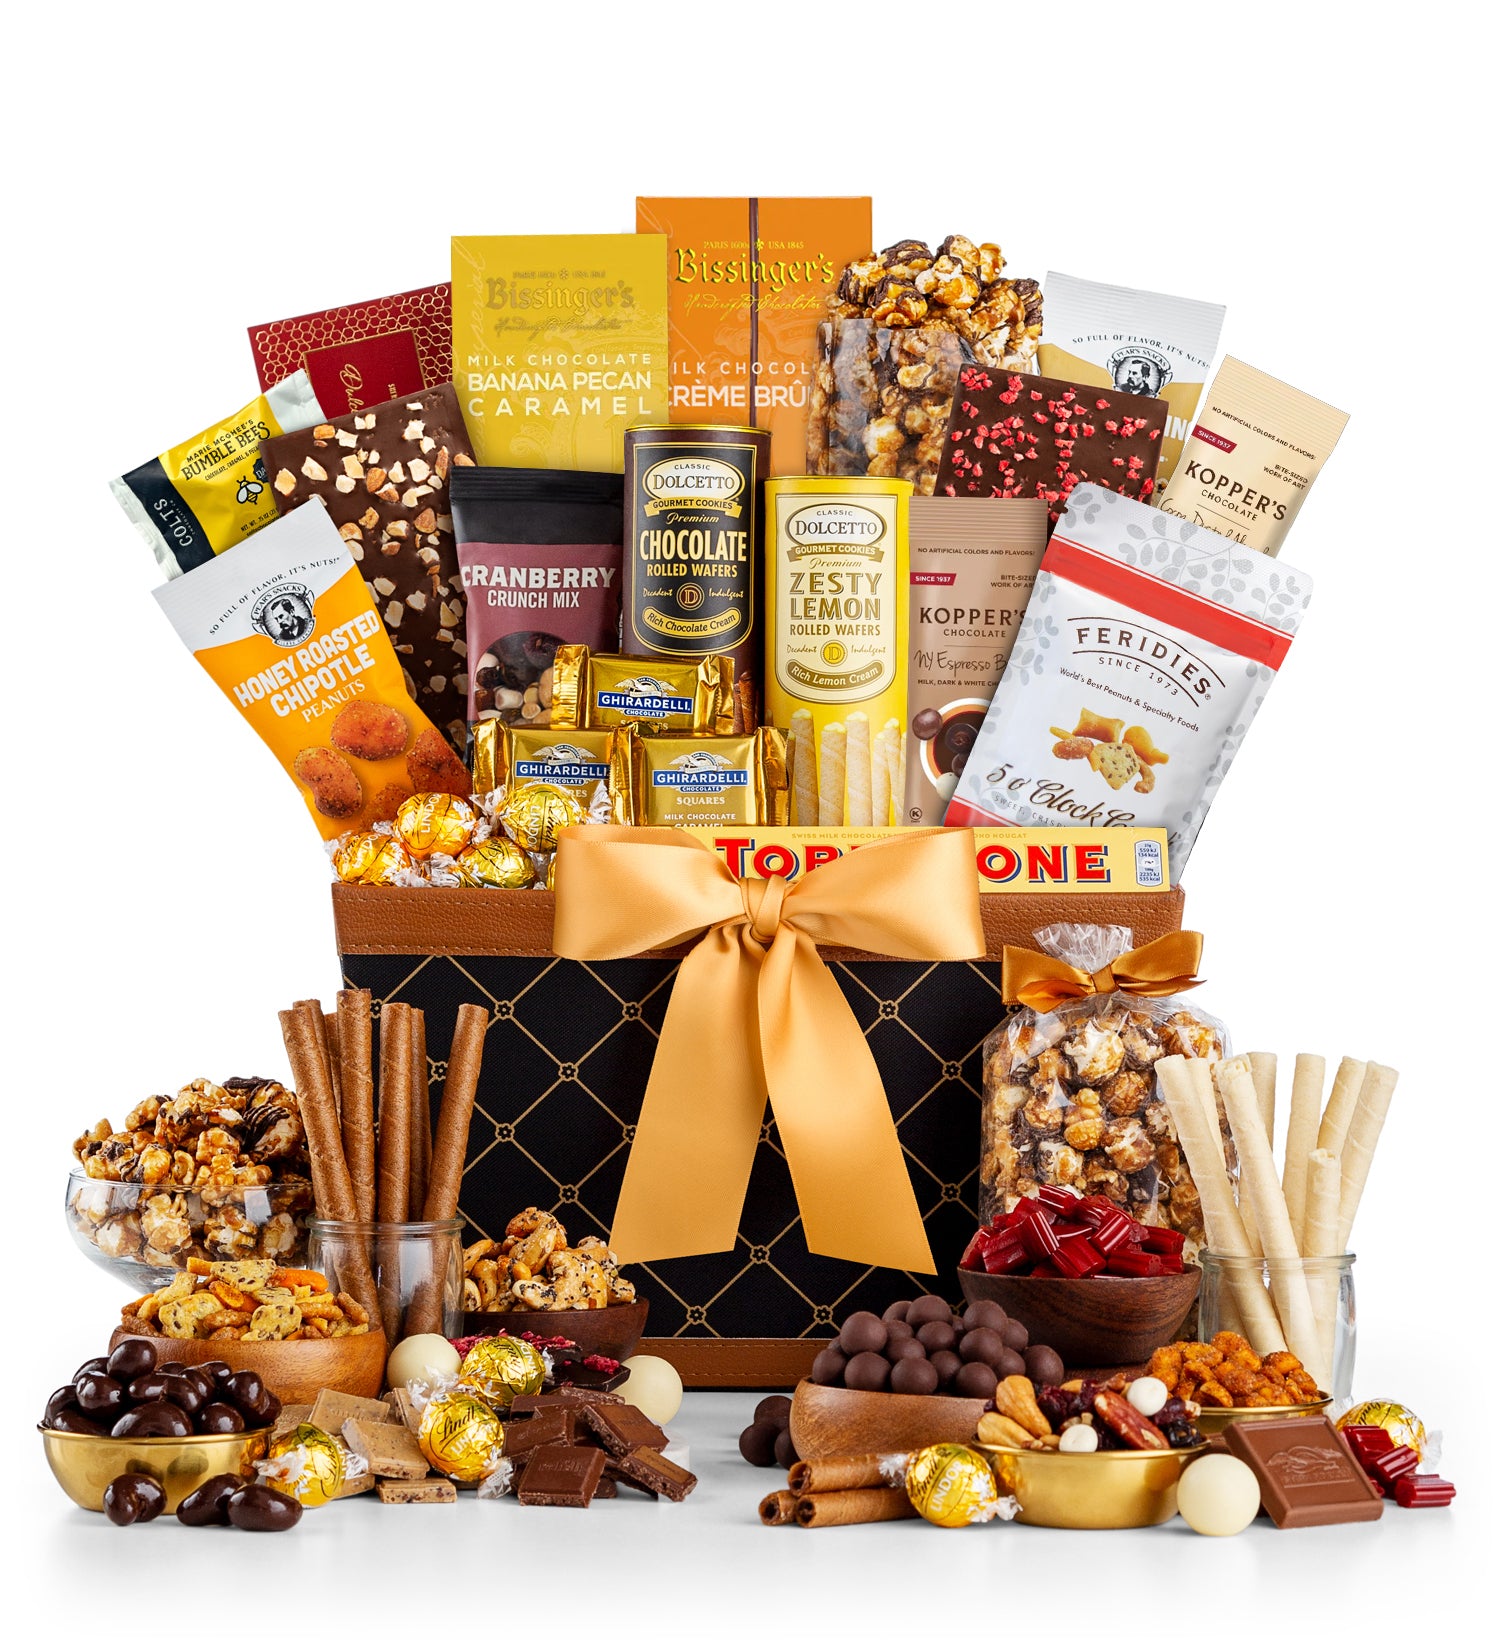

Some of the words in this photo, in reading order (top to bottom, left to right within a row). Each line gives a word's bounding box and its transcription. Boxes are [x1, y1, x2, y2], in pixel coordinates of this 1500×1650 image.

[768, 240, 785, 249] USA
[675, 247, 835, 293] Bissinger's
[485, 276, 635, 317] Bissinger's
[468, 355, 516, 367] MILK
[527, 353, 652, 366] CHOCOLATE
[672, 362, 707, 375] ILK
[468, 372, 568, 392] BANANA
[572, 371, 652, 391] PECAN
[468, 396, 652, 416] CARAMEL
[1164, 414, 1191, 441] IN
[1212, 406, 1221, 414] NO
[1221, 410, 1251, 430] ARTIFICIAL
[1252, 426, 1276, 441] COLORS
[1275, 437, 1289, 447] AND
[1197, 430, 1217, 443] SINCE
[1216, 438, 1233, 449] 1937
[181, 441, 236, 480] BUMBLE
[236, 421, 271, 448] BEES
[186, 444, 212, 462] MARIE
[652, 474, 735, 490] DOLCETTO
[1263, 466, 1284, 480] WORK
[1282, 475, 1293, 484] OF
[1292, 480, 1306, 491] ART
[1274, 464, 1309, 484] BITE-SIZED
[1184, 459, 1288, 521] KOPPER'S
[652, 498, 695, 509] GOURMET
[695, 498, 734, 510] COOKIES
[816, 509, 854, 517] CLASSIC
[1201, 489, 1258, 522] CHOCOLATE
[153, 498, 193, 547] COLTS
[666, 512, 720, 525] Premium
[795, 520, 878, 536] DOLCETTO
[640, 529, 748, 562] CHOCOLATE
[795, 544, 837, 555] GOURMET
[837, 544, 877, 555] COOKIES
[928, 547, 962, 555] ARTIFICIAL
[646, 563, 688, 577] ROLLED
[691, 564, 738, 578] WAFERS
[808, 557, 863, 570] Premium
[461, 564, 616, 589] CRANBERRY
[789, 571, 883, 595] ZESTY
[272, 585, 302, 595] SNACKS
[487, 589, 548, 609] CRUNCH
[552, 591, 580, 609] MIX
[642, 587, 673, 598] Decadent
[708, 587, 745, 601] Indulgent
[209, 624, 220, 635] SO
[219, 603, 238, 623] FULL
[238, 594, 250, 604] OF
[790, 597, 881, 621] LEMON
[647, 612, 664, 630] Rich
[665, 620, 709, 633] Chocolate
[709, 614, 736, 630] Cream
[789, 623, 831, 636] ROLLED
[835, 623, 881, 636] WAFERS
[943, 628, 1006, 638] CHOCOLATE
[233, 655, 300, 708] HONEY
[295, 609, 381, 673] ROASTED
[786, 645, 818, 654] Decadent
[850, 645, 887, 657] Indulgent
[913, 649, 934, 671] NY
[937, 650, 991, 678] Espresso
[270, 643, 376, 717] CHIPOTLE
[791, 666, 811, 682] Rich
[812, 672, 846, 687] Lemon
[849, 666, 880, 683] Cream
[917, 679, 936, 687] MILK,
[1098, 656, 1141, 673] SINCE
[1149, 672, 1179, 696] 1973
[301, 678, 366, 723] PEANUTS
[1060, 667, 1086, 683] World's
[1086, 676, 1103, 690] Best
[1103, 685, 1133, 704] Peanuts
[1133, 698, 1140, 706] &
[1142, 701, 1176, 723] Specialty
[1176, 716, 1200, 732] Foods
[626, 709, 664, 717] CHOCOLATE
[676, 796, 725, 807] SQUARES
[986, 763, 1014, 783] 5
[1029, 779, 1104, 827] Clock
